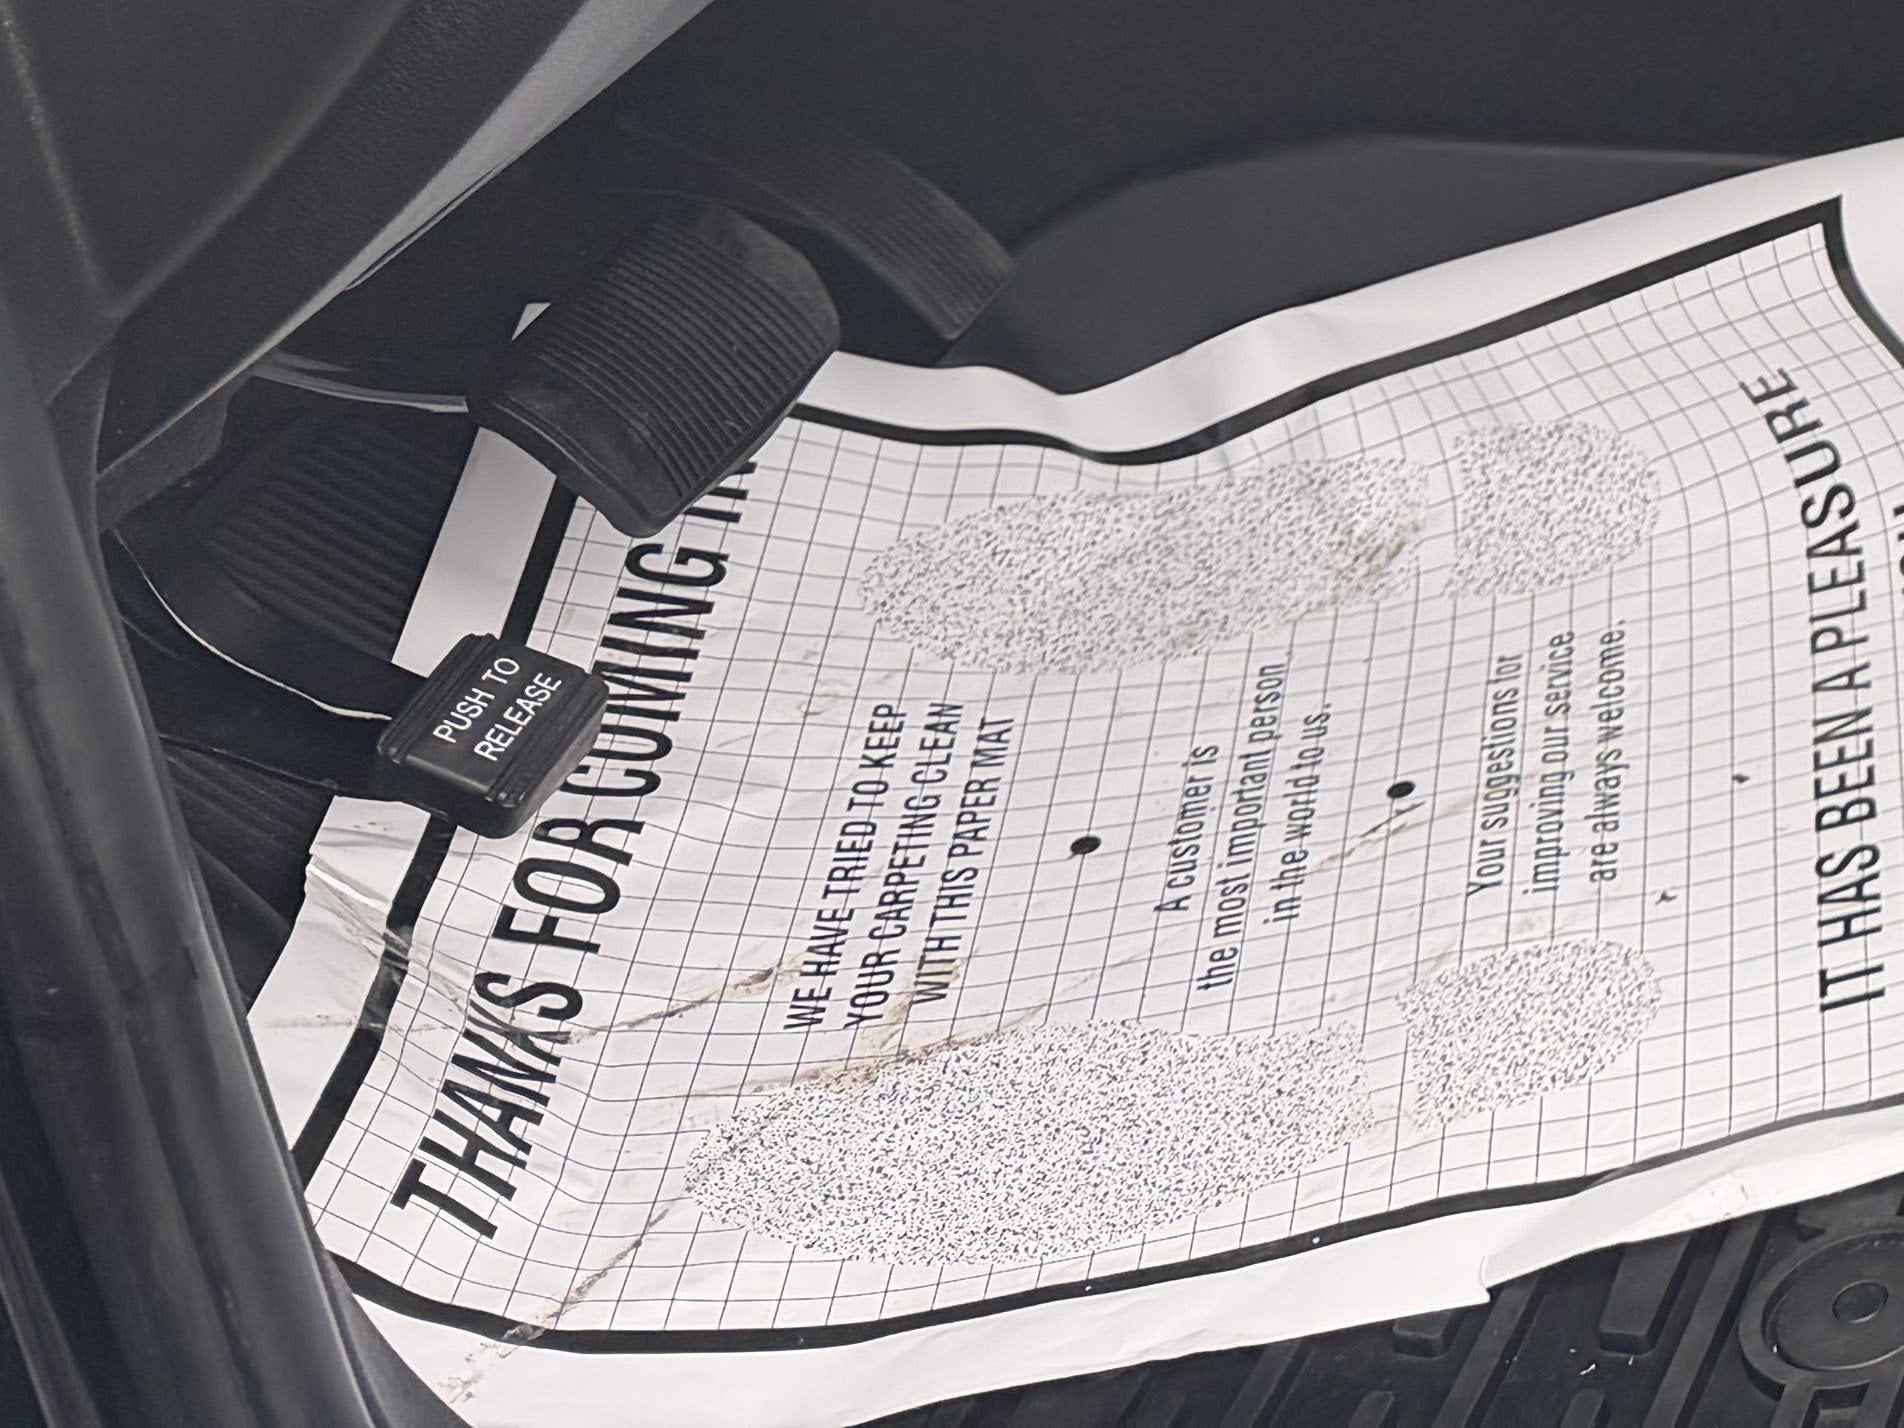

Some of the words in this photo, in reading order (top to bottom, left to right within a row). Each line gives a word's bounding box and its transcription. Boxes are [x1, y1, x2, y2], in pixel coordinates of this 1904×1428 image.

[1739, 367, 1870, 655] PLEASURE
[432, 687, 495, 744] PUSH
[481, 657, 520, 685] TO
[558, 544, 729, 798] COMING
[1247, 662, 1286, 746] person
[1486, 652, 1523, 685] for
[1538, 630, 1575, 717] service
[1589, 619, 1626, 745] welcome.
[1811, 660, 1872, 694] A
[473, 672, 562, 762] RELEASE
[859, 703, 907, 770] KEEP
[910, 702, 964, 785] CLEAN
[970, 716, 1015, 768] MAT
[1302, 702, 1332, 741] us.
[1542, 725, 1570, 765] our
[1181, 744, 1219, 768] is
[1289, 745, 1325, 772] to
[1480, 686, 1522, 832] suggestions
[1584, 749, 1631, 834] always
[1813, 706, 1878, 832] BEEN
[846, 779, 889, 812] TO
[949, 776, 1002, 859] PAPER
[1167, 768, 1215, 890] customer
[1217, 748, 1274, 869] important
[1282, 776, 1319, 844] world
[822, 821, 877, 900] TRIED
[868, 794, 941, 941] CARPETING
[1466, 837, 1507, 897] Your
[1522, 770, 1575, 894] improving
[1589, 842, 1619, 883] are
[492, 817, 645, 954] FOR
[929, 866, 979, 929] THIS
[1154, 894, 1191, 912] A
[1215, 872, 1251, 938] most
[1269, 849, 1310, 892] the
[1815, 843, 1884, 948] HAS
[800, 908, 855, 977] HAVE
[1263, 898, 1301, 924] in
[843, 947, 901, 1030] YOUR
[911, 934, 962, 1005] WITH
[1197, 946, 1239, 991] the
[1819, 963, 1886, 1013] IT
[783, 986, 832, 1030] WE
[390, 972, 583, 1239] THANKS
